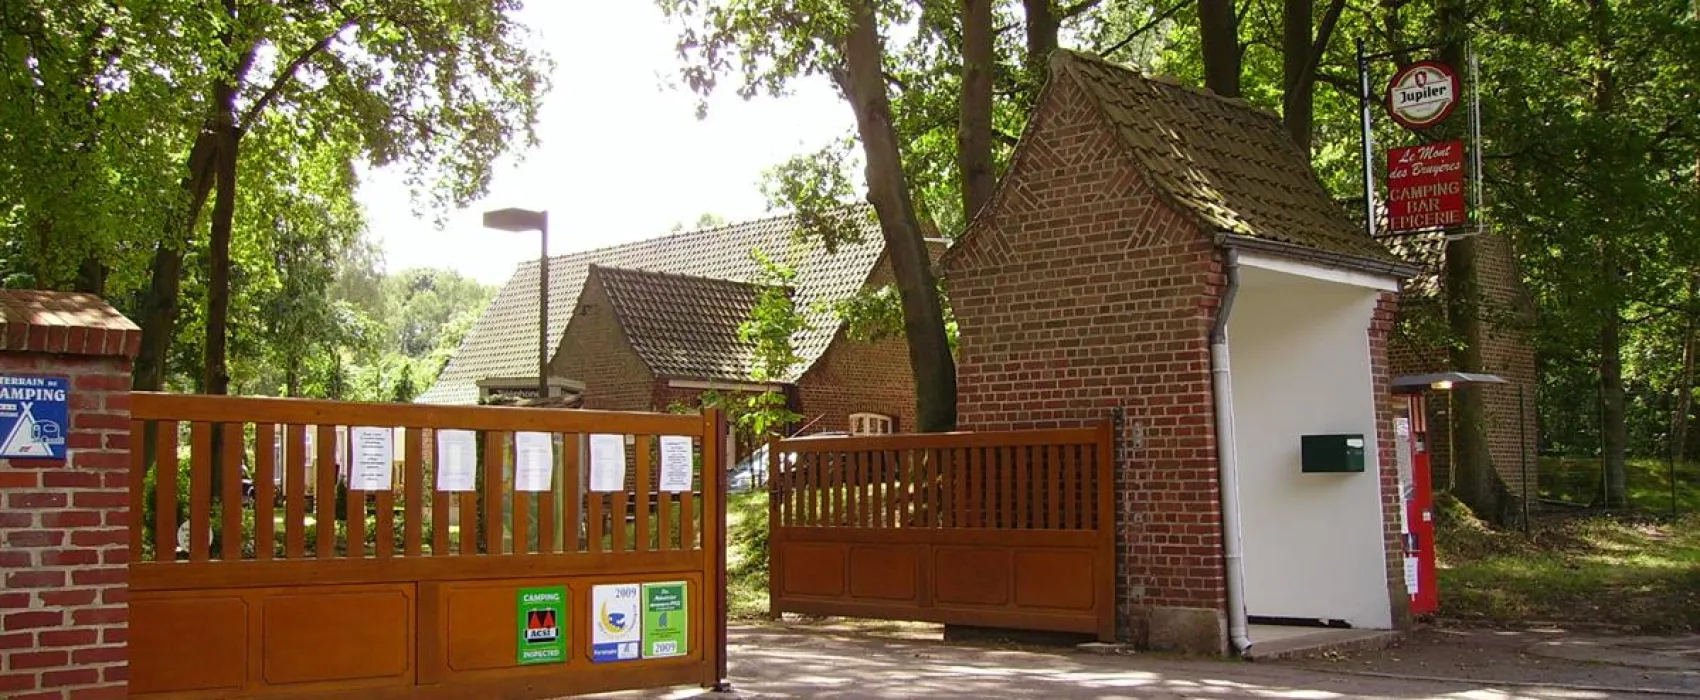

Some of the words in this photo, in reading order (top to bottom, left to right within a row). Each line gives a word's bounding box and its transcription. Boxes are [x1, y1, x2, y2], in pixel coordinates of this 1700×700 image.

[1400, 85, 1447, 104] Jupiler
[1398, 149, 1416, 163] Le
[1418, 146, 1451, 160] Mont
[1389, 167, 1408, 179] des
[1390, 181, 1460, 201] CAMPING
[1407, 198, 1440, 214] BAR
[1390, 209, 1461, 230] EPICERIE
[0, 388, 65, 401] AMPING
[523, 593, 560, 602] CAMPING
[615, 588, 637, 599] 2009
[655, 643, 675, 653] 2009
